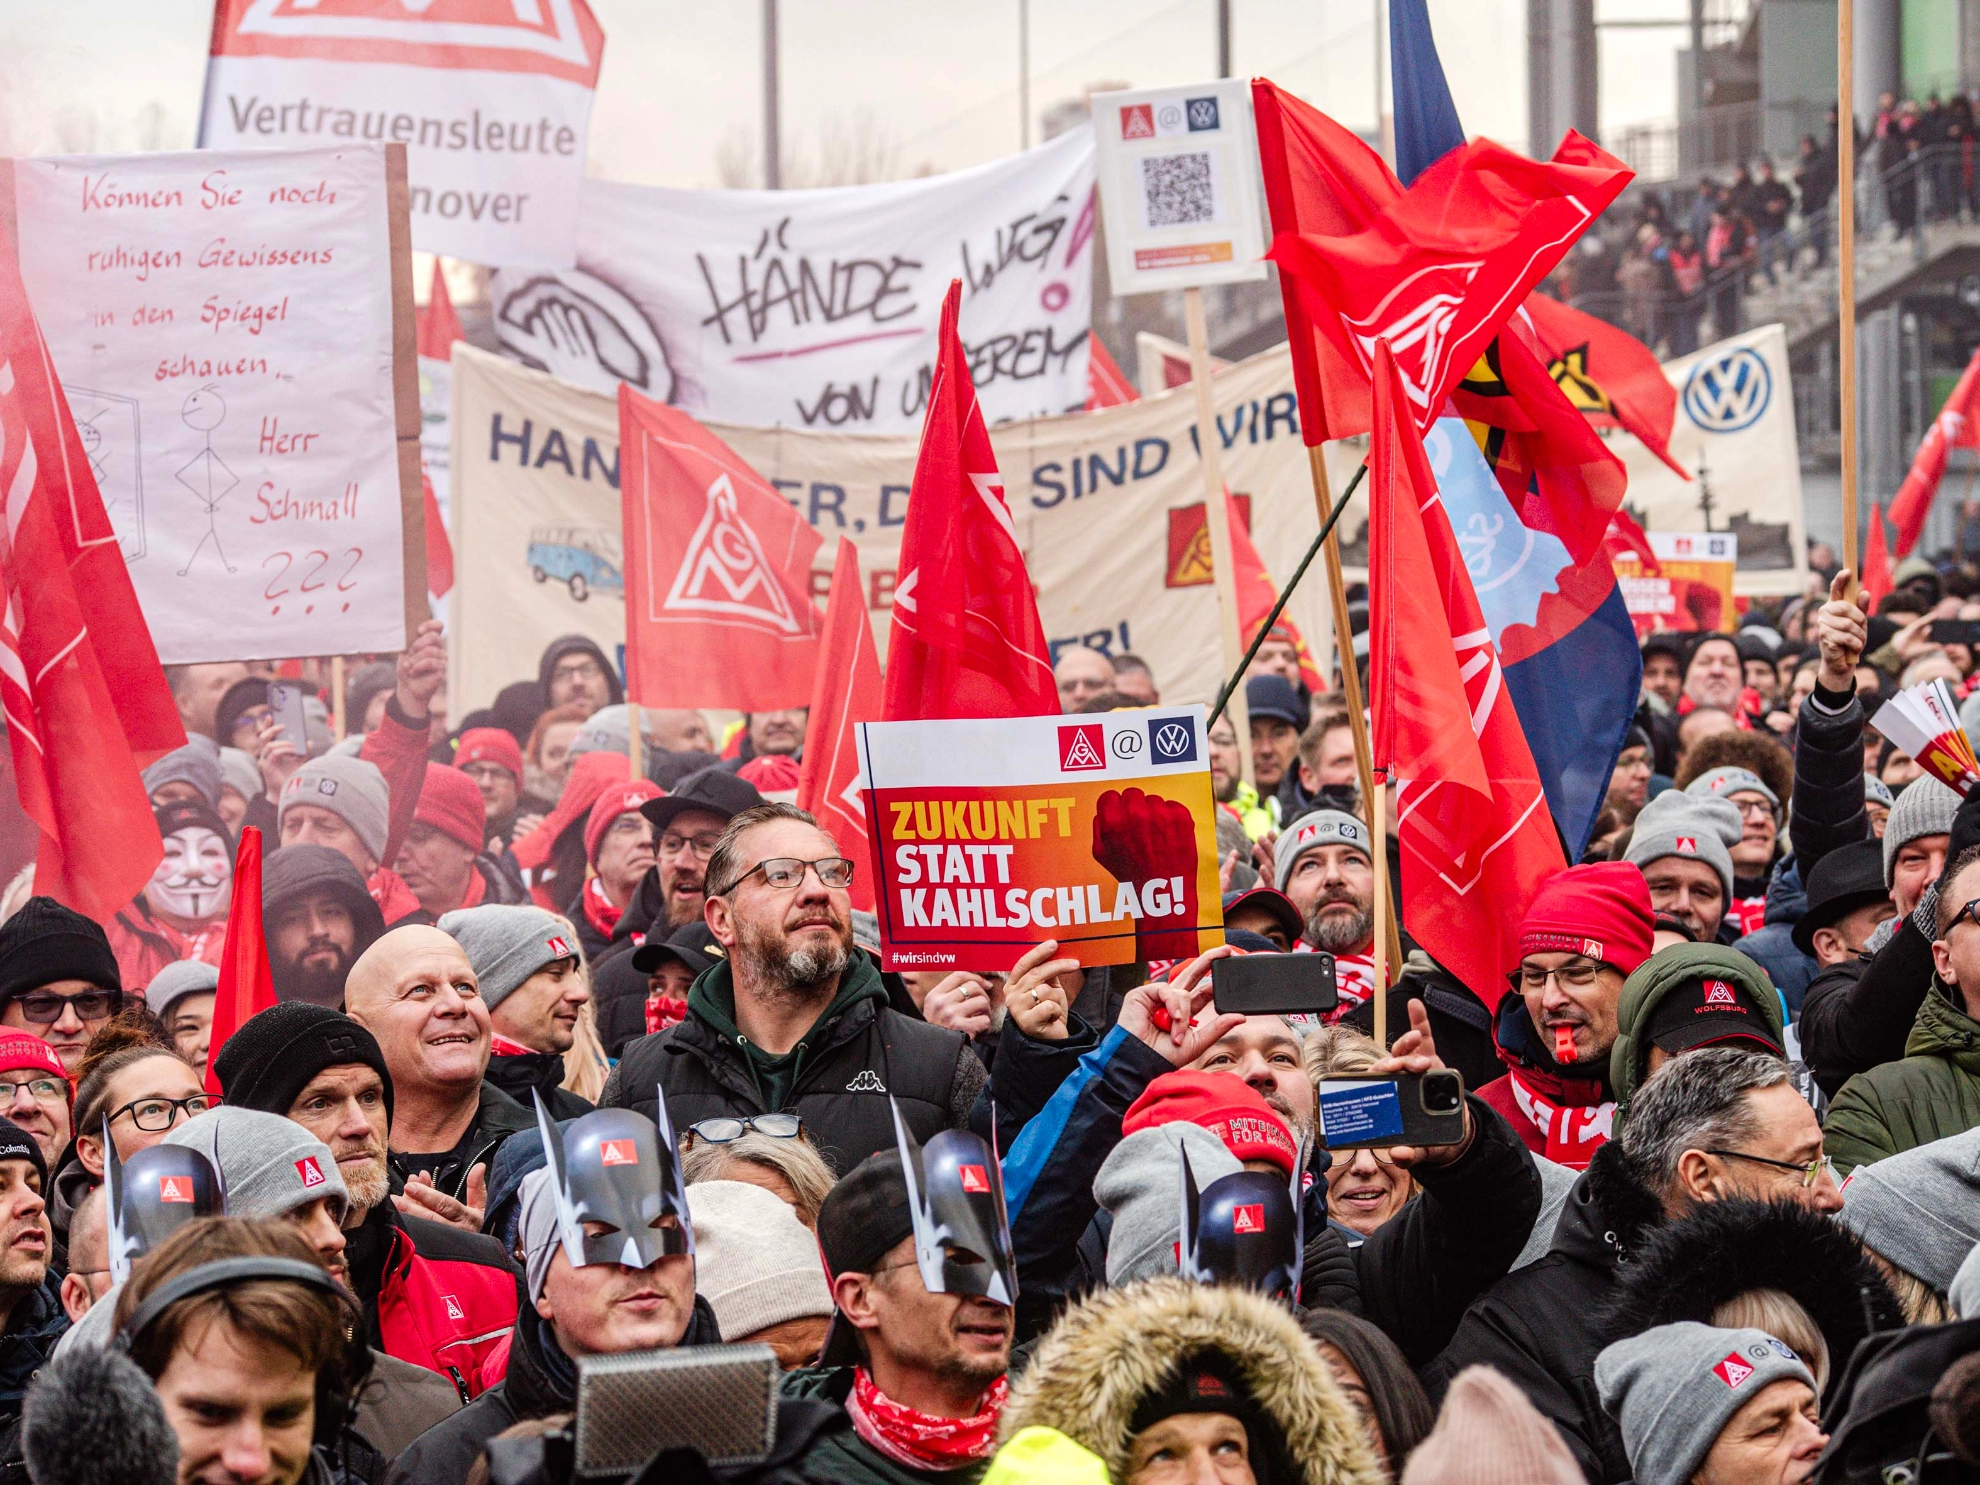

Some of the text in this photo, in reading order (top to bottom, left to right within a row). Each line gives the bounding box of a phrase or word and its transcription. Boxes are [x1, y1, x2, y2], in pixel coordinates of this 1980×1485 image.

[228, 95, 576, 156] Vertrauensleute
[82, 170, 337, 212] Können Sie noch
[411, 187, 531, 224] nover
[87, 237, 334, 282] ruhigen Gewissens
[697, 216, 924, 345] HÄNDE
[93, 295, 289, 336] in den Spiegel
[796, 376, 880, 427] VON
[259, 415, 320, 456] Herr
[1030, 436, 1170, 510] SIND
[1189, 393, 1302, 461] WIR
[262, 547, 364, 616] ???
[1111, 729, 1143, 760] @
[1155, 723, 1190, 758] VW
[890, 797, 1076, 841] ZUKUNFT
[895, 844, 1014, 885] STATT
[899, 875, 1187, 928] KAHLSCHLAG!
[891, 952, 956, 965] #wirsindvw
[1694, 1004, 1748, 1015] WOLFSBURG
[0, 1144, 31, 1155] Columbia
[1232, 1127, 1264, 1144] FÜR
